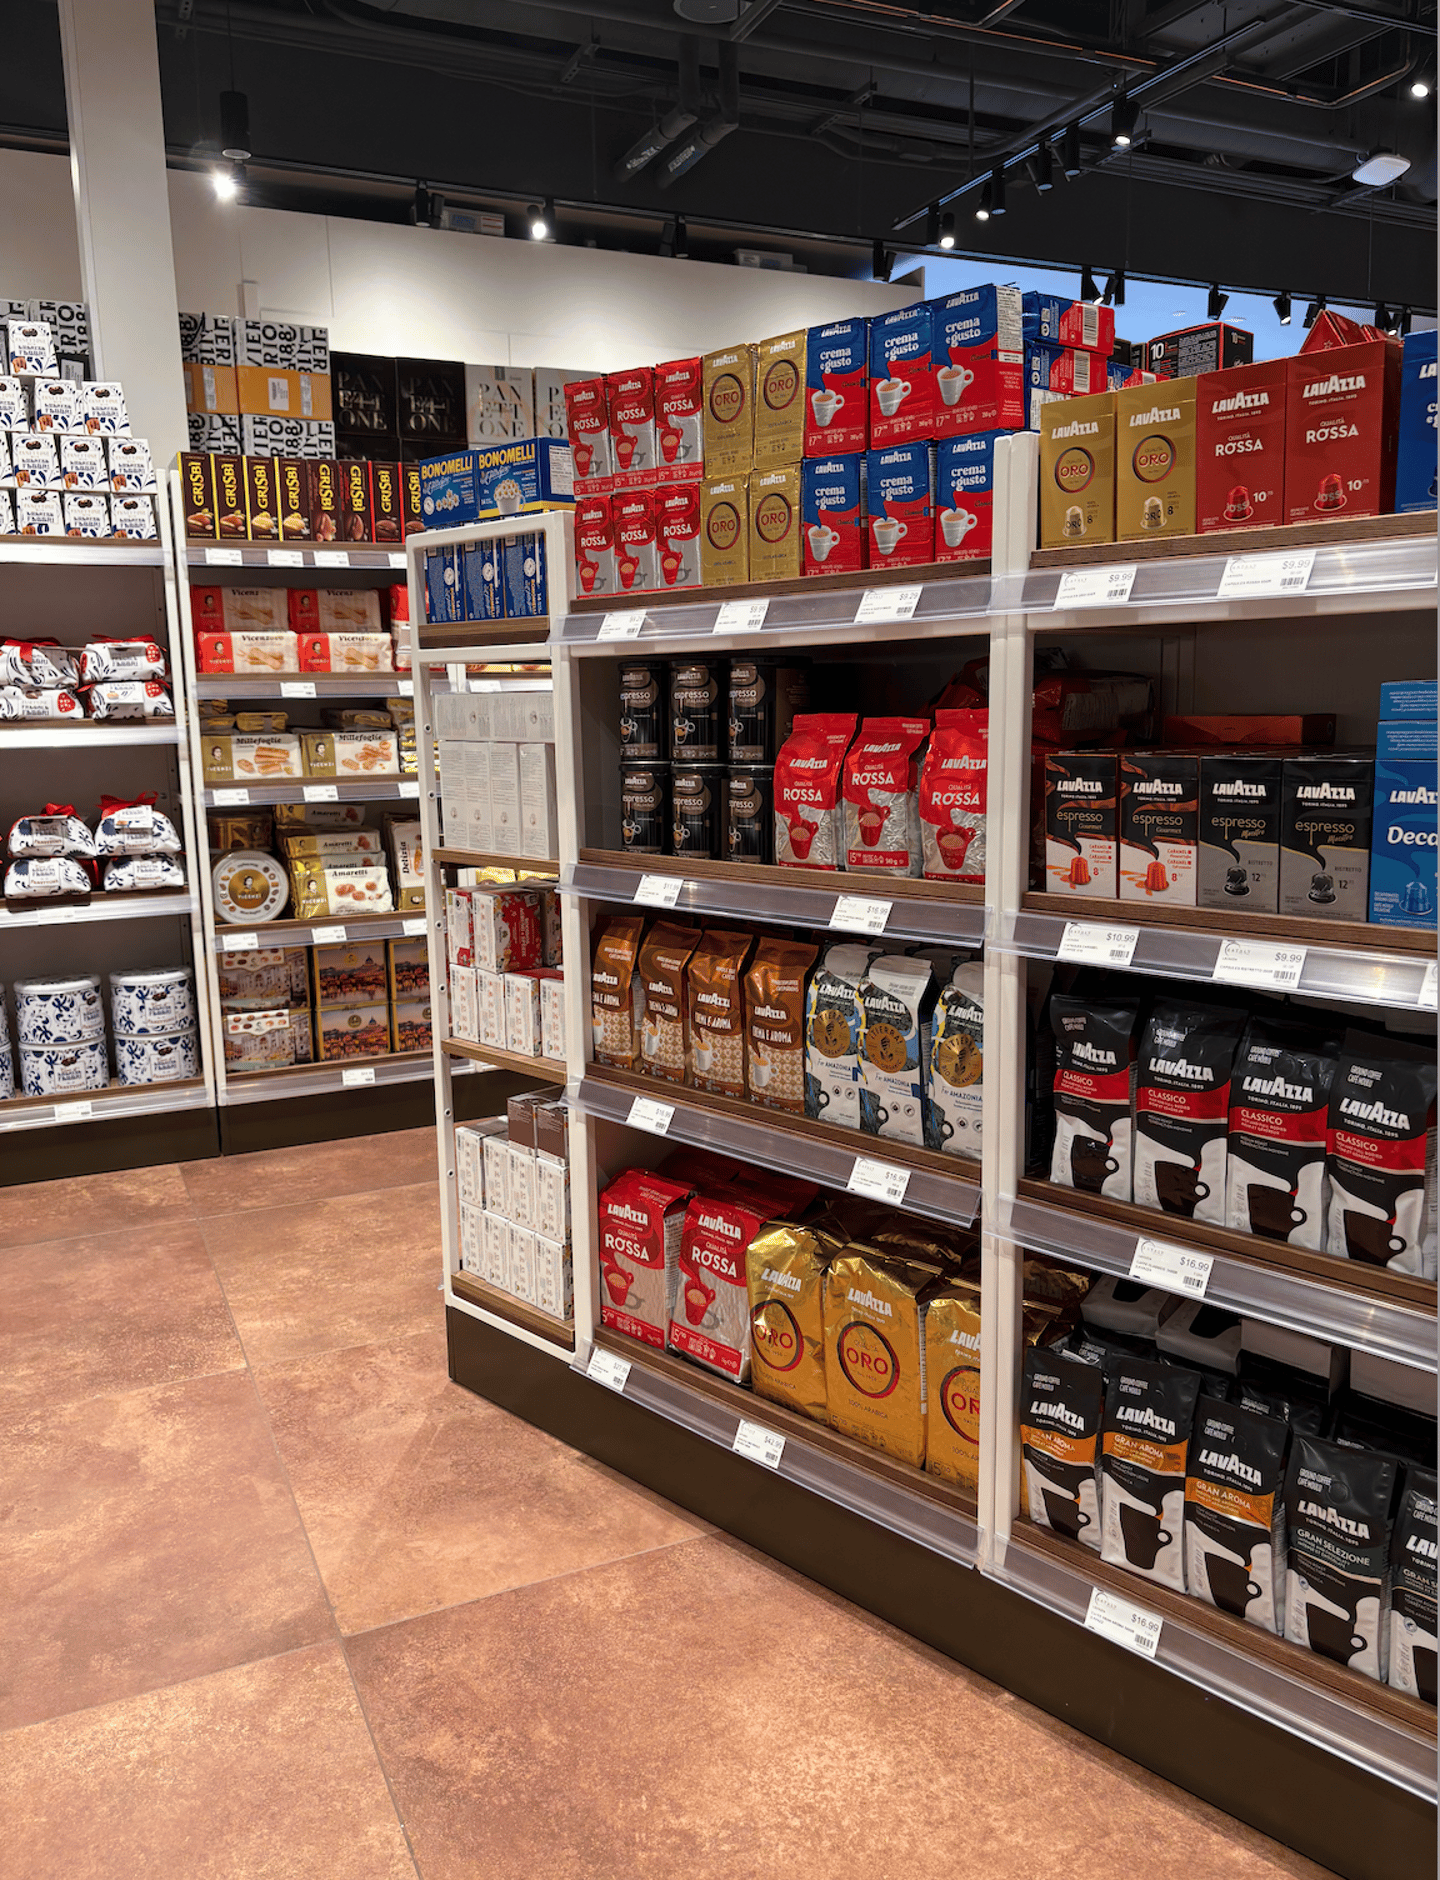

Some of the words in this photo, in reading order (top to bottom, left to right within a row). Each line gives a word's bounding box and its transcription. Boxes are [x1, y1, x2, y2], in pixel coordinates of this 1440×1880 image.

[945, 291, 980, 309] LAVAZZA
[945, 316, 981, 334] crema
[884, 331, 919, 348] crema
[951, 328, 981, 348] gusto
[819, 347, 852, 360] crema
[890, 342, 919, 362] gusto
[1150, 342, 1165, 360] 10
[824, 356, 852, 375] gusto
[479, 383, 522, 402] PAN
[769, 377, 793, 393] ORO
[1302, 374, 1366, 398] LAVAZZA
[663, 398, 694, 414] ROSSA
[714, 391, 739, 406] ORO
[1211, 391, 1270, 414] LAVAZZA
[338, 410, 387, 430] ONE
[616, 407, 646, 421] ROSSA
[1129, 406, 1182, 427] LAVAZZA
[479, 420, 525, 438] ONE
[573, 417, 600, 431] ROSSA
[1051, 420, 1099, 440] LAVAZZA
[1305, 424, 1360, 444] ROSSA
[952, 439, 986, 454] LAVAZZA
[1215, 438, 1264, 457] ROSSA
[479, 443, 535, 470] BONOMELLI
[880, 451, 912, 465] LAVAZZA
[1138, 451, 1170, 468] ORO
[421, 455, 473, 480] BONOMELLI
[951, 464, 986, 478] crema
[1060, 463, 1090, 479] ORO
[880, 475, 913, 488] crema
[955, 474, 987, 492] gusto
[815, 486, 845, 497] crema
[885, 485, 914, 501] gusto
[819, 496, 846, 511] gusto
[712, 520, 735, 533] ORO
[760, 511, 787, 526] ORO
[620, 529, 648, 542] ROSSA
[663, 523, 693, 537] ROSSA
[580, 535, 607, 548] ROSSA
[1282, 559, 1311, 571] $9.99
[1108, 572, 1133, 584] $9.99
[236, 736, 282, 745] Millefoglie
[338, 734, 383, 742] Millefoglie
[789, 757, 828, 770] LAVAZZA
[940, 755, 987, 770] LAVAZZA
[851, 771, 895, 786] ROSSA
[1056, 777, 1103, 793] LAVAZZA
[1132, 778, 1183, 796] LAVAZZA
[783, 787, 823, 802] ROSSA
[1212, 780, 1267, 797] LAVAZZA
[1296, 782, 1356, 801] LAVAZZA
[931, 791, 980, 806] ROSSA
[1056, 811, 1104, 827] espresso
[1132, 814, 1184, 831] espresso
[1211, 817, 1266, 835] espresso
[1295, 821, 1355, 840] espresso
[399, 841, 409, 874] Delizia
[332, 869, 368, 877] Amaretti
[1105, 931, 1136, 943] $10.99
[1274, 951, 1302, 963] $9.99
[754, 1004, 787, 1020] LAVAZZA
[864, 996, 907, 1015] LAVAZZA
[770, 1030, 792, 1044] AROMA
[1149, 1057, 1215, 1082] LAVAZZA
[882, 1075, 911, 1087] AMAZONIA
[1062, 1070, 1093, 1087] CLASSICO
[1148, 1089, 1186, 1104] CLASSICO
[1242, 1076, 1313, 1103] LAVAZZA
[1240, 1109, 1283, 1126] CLASSICO
[1338, 1097, 1410, 1130] LAVAZZA
[1335, 1131, 1378, 1152] CLASSICO
[884, 1171, 907, 1184] $16.99
[607, 1202, 649, 1226] LAVAZZA
[698, 1213, 742, 1240] LAVAZZA
[604, 1233, 650, 1261] ROSSA
[691, 1245, 738, 1277] ROSSA
[1180, 1256, 1210, 1272] $16.99
[760, 1267, 802, 1292] LAVAZZA
[847, 1287, 893, 1318] LAVAZZA
[754, 1324, 793, 1349] ORO
[846, 1347, 889, 1375] ORO
[1029, 1400, 1085, 1432] LAVAZZA
[1115, 1405, 1176, 1437] LAVAZZA
[1114, 1434, 1138, 1448] GRAN
[1138, 1443, 1164, 1459] AROMA
[1198, 1449, 1262, 1487] LAVAZZA
[1195, 1480, 1221, 1497] GRAN
[1221, 1490, 1251, 1510] AROMA
[1297, 1499, 1371, 1540] LAVAZZA
[1297, 1528, 1322, 1544] GRAN
[1322, 1536, 1371, 1567] SELEZIONE
[1403, 1567, 1430, 1584] GRAN
[1131, 1613, 1160, 1633] $16.99
